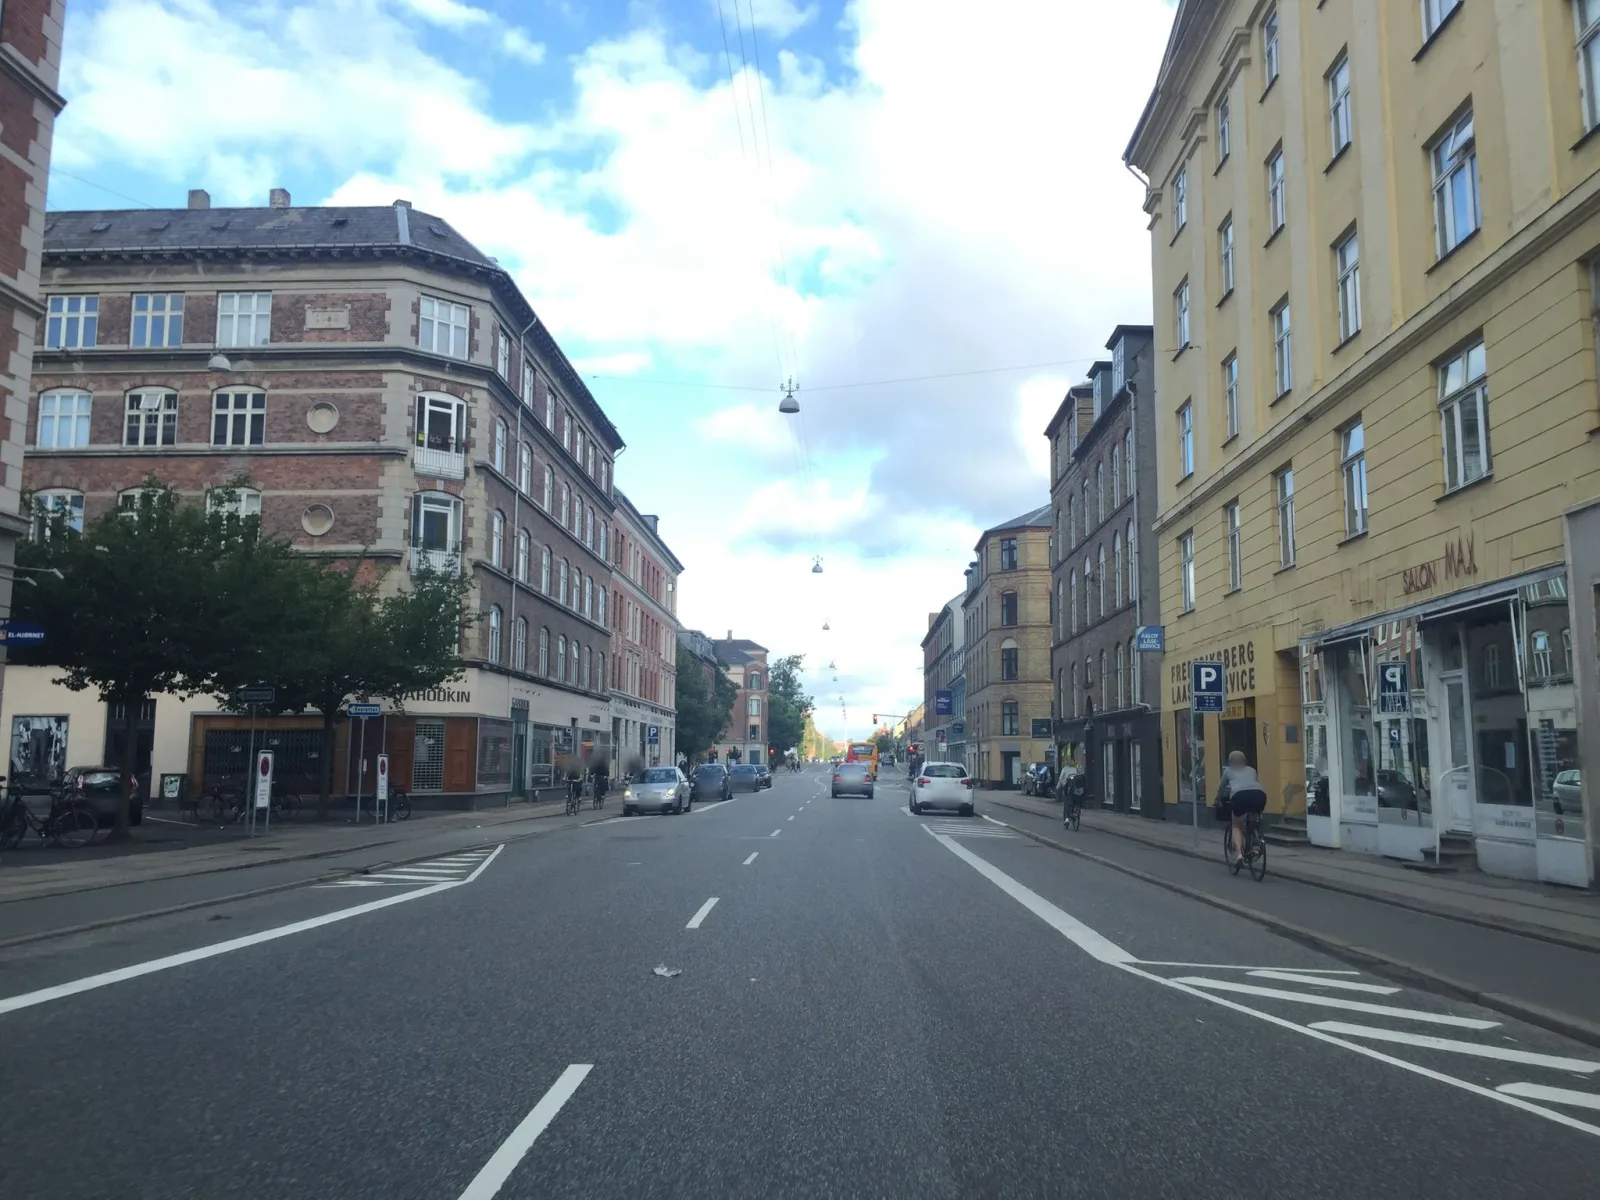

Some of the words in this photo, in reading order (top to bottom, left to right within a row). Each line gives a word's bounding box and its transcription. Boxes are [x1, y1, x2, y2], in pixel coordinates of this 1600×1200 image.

[1403, 562, 1437, 595] SALON
[1445, 530, 1478, 580] MAX
[1171, 641, 1255, 683] FREBERG
[1200, 667, 1217, 690] P
[650, 727, 657, 737] P
